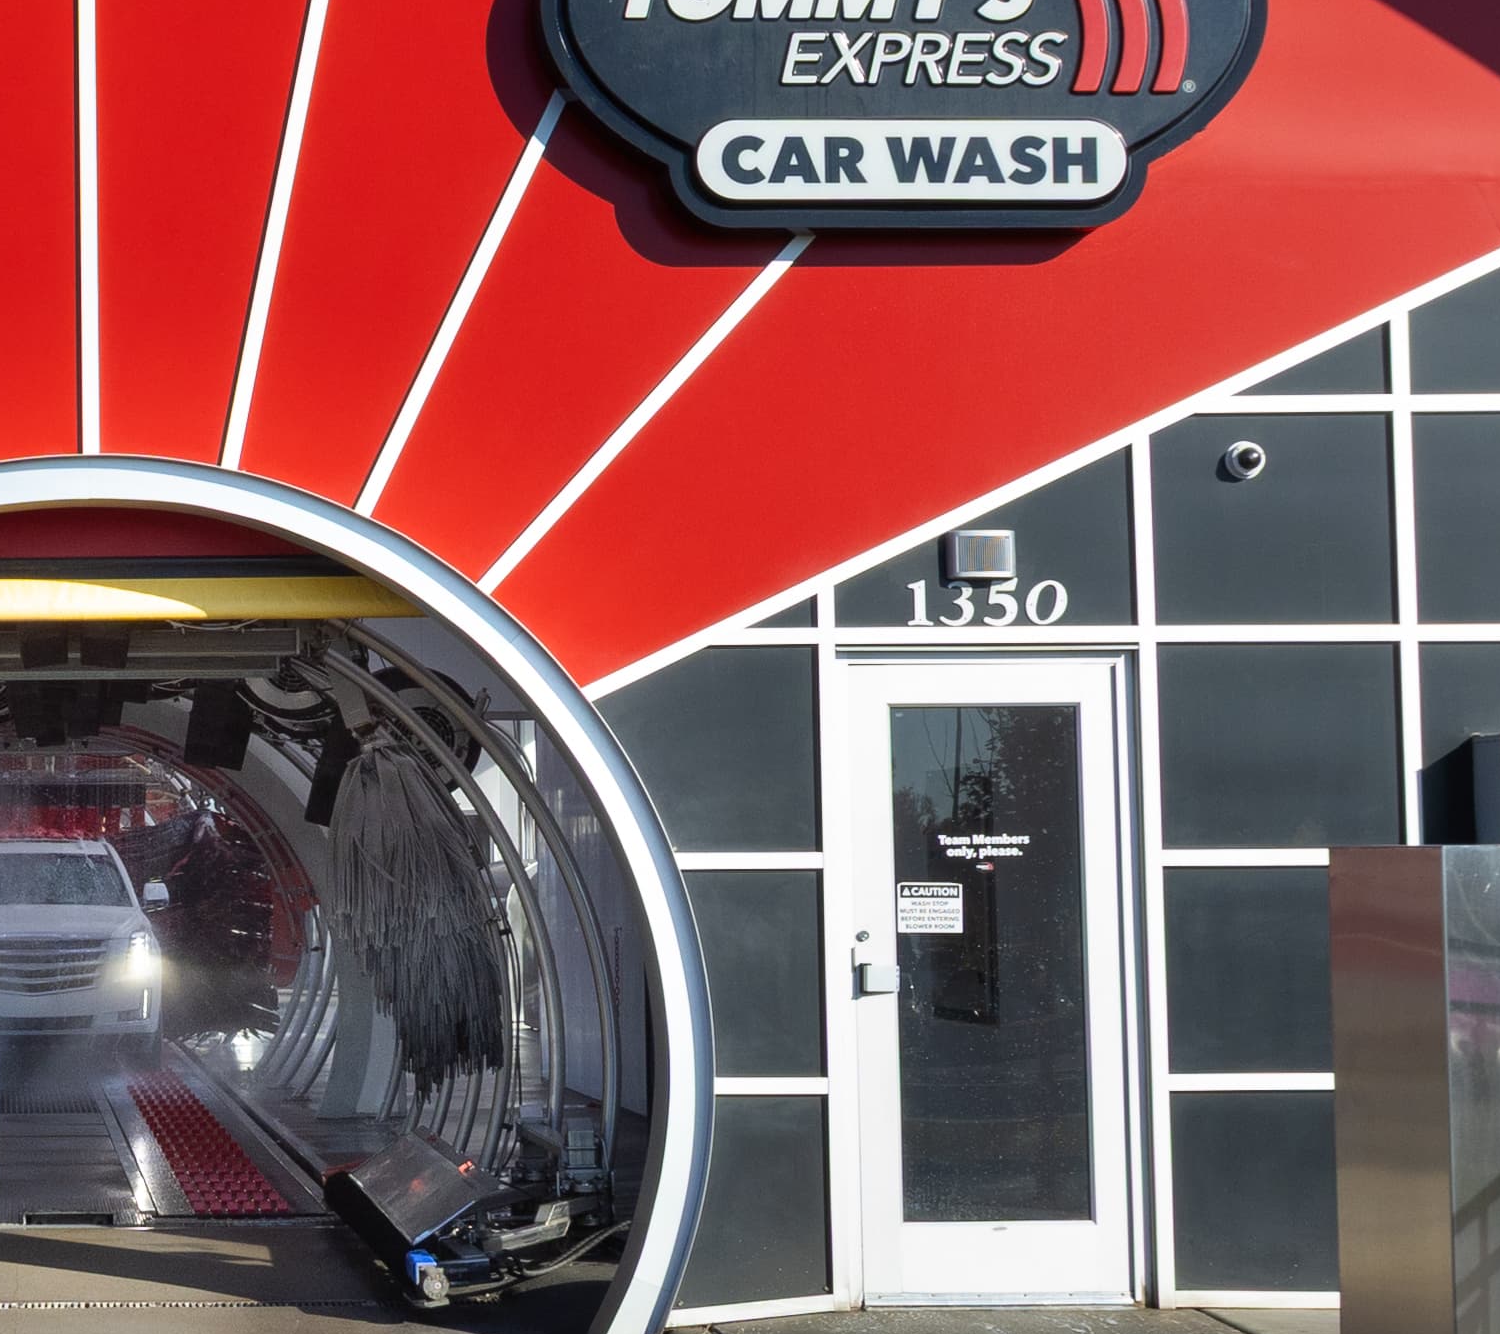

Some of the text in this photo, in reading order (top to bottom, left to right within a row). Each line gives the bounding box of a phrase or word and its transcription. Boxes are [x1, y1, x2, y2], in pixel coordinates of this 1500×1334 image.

[781, 31, 1068, 86] EXPRESS
[721, 135, 1099, 185] CAR WASH
[907, 578, 1068, 626] 1350
[938, 833, 1031, 845] Team Members
[946, 845, 1024, 859] only, please.
[911, 887, 958, 896] CAUTION
